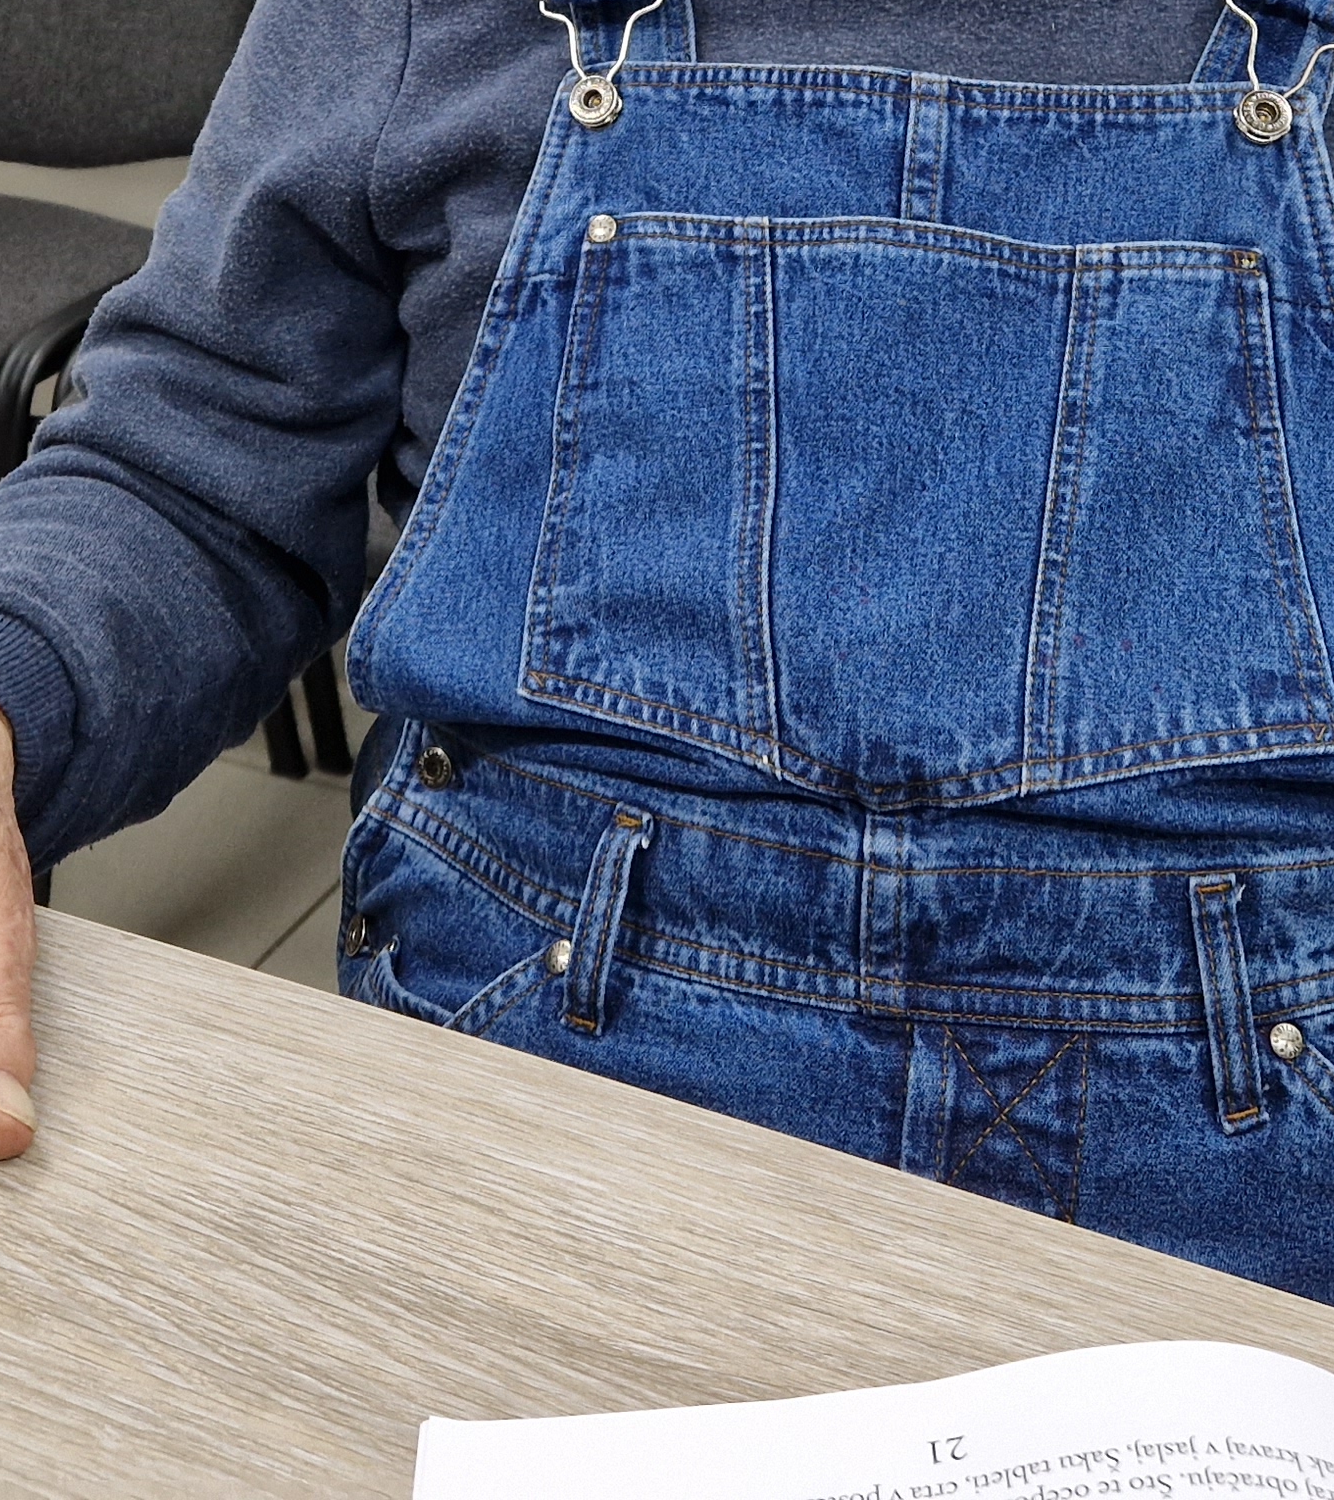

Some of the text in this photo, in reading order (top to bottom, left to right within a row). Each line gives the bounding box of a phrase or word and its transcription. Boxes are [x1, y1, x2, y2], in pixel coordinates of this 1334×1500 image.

[927, 1435, 968, 1465] 21
[1059, 1448, 1121, 1474] Šaku
[1126, 1435, 1197, 1465] jaslaj,
[1205, 1441, 1221, 1456] v
[1225, 1436, 1304, 1473] kravaj
[910, 1480, 959, 1500] crta
[965, 1458, 1051, 1494] tableti,
[1098, 1479, 1123, 1495] te
[1128, 1473, 1173, 1499] Što
[1179, 1465, 1298, 1499] obračaju.
